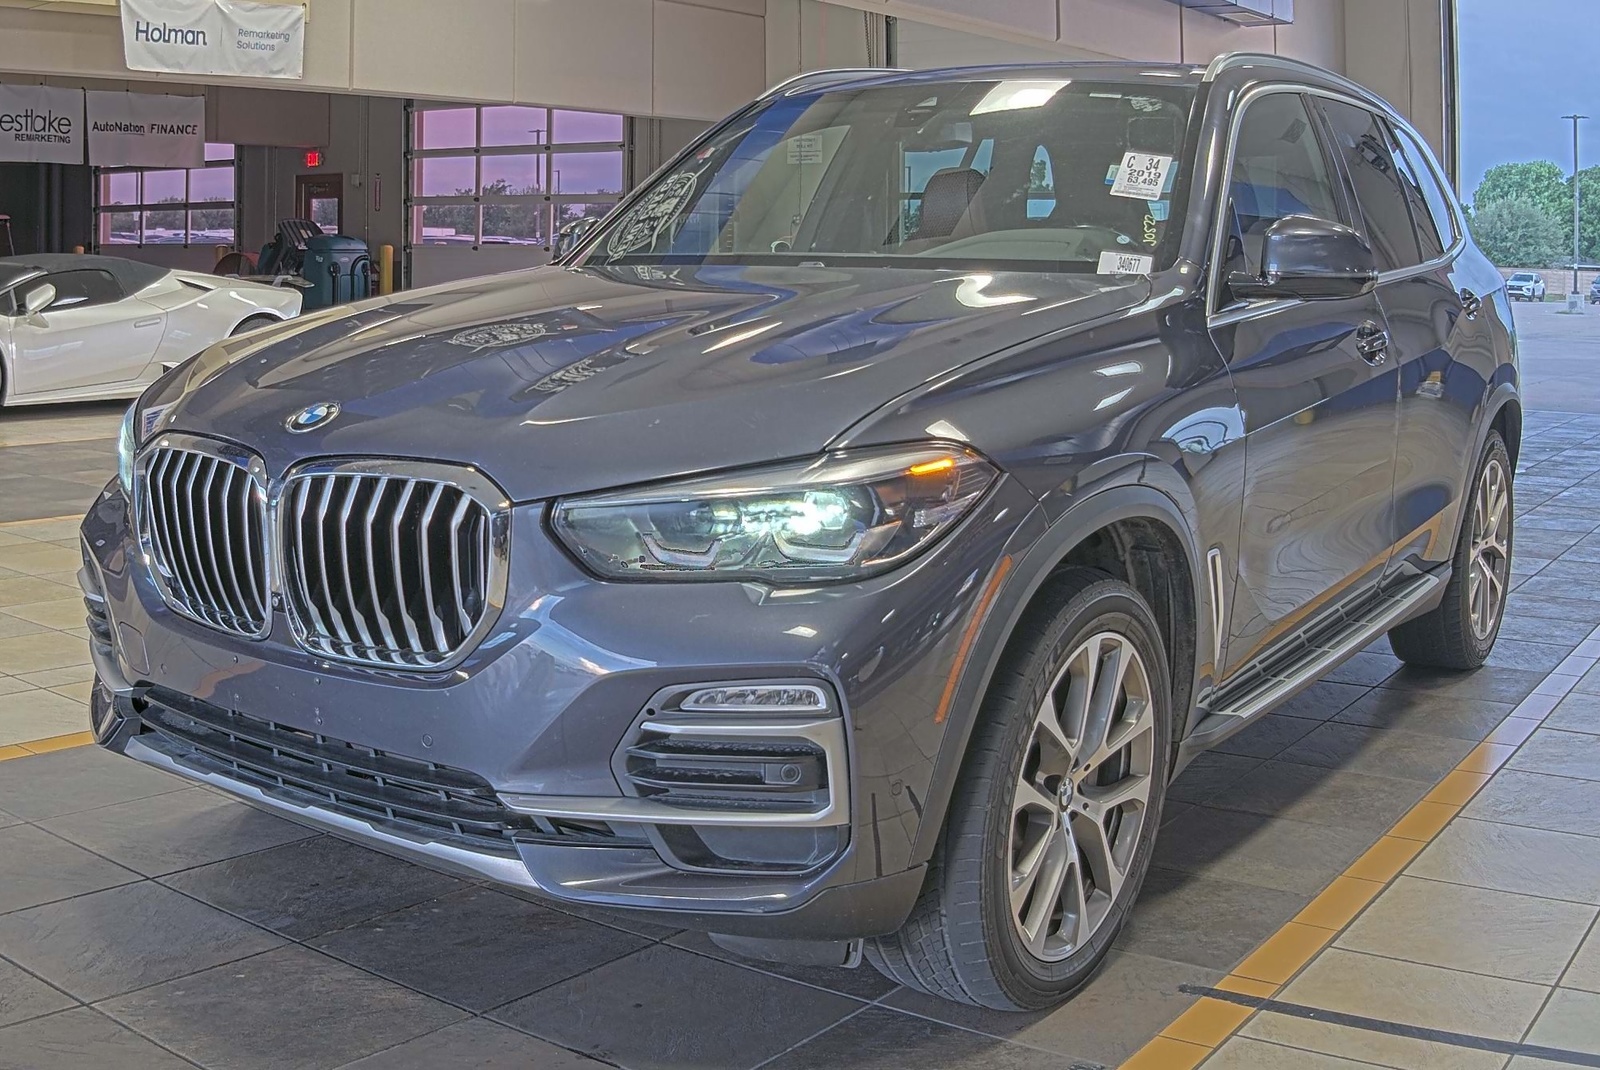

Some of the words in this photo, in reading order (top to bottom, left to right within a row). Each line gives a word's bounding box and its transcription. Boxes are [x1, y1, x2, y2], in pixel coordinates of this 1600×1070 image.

[135, 20, 207, 46] Holman
[238, 28, 290, 42] Remarketing
[236, 40, 276, 52] Solutions
[92, 121, 145, 134] AutoNation
[150, 123, 198, 136] FINANCE
[15, 133, 71, 144] REMARKETING
[1126, 155, 1136, 169] C
[1145, 157, 1161, 172] 34
[1127, 168, 1162, 179] 2019
